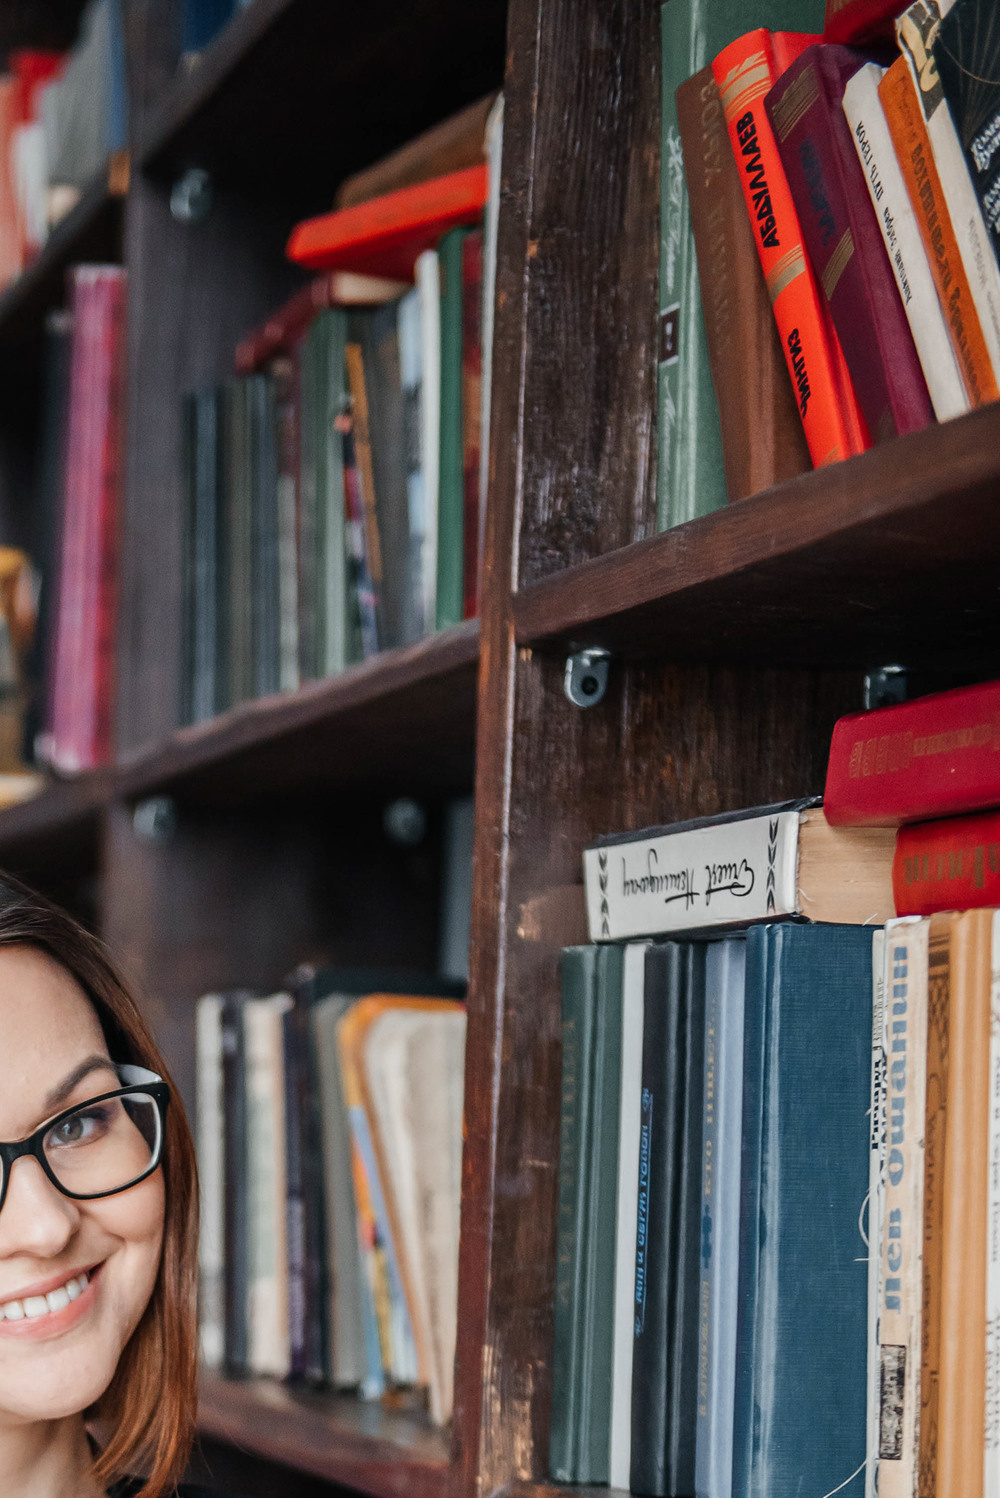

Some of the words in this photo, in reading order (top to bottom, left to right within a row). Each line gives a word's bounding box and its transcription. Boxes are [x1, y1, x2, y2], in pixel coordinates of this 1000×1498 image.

[855, 120, 874, 166] ГЕРОЯ
[737, 111, 780, 249] АБДУЛЛАЕВ
[870, 164, 884, 203] ПУТЬ
[786, 327, 812, 420] ЧИНГИЗ
[622, 848, 700, 911] Hemingway
[705, 857, 755, 898] Ernest
[888, 945, 910, 1188] Ошанин
[639, 1122, 650, 1188] ГОЛОН
[637, 1192, 649, 1250] СЕРЖ
[884, 1206, 902, 1315] Лев
